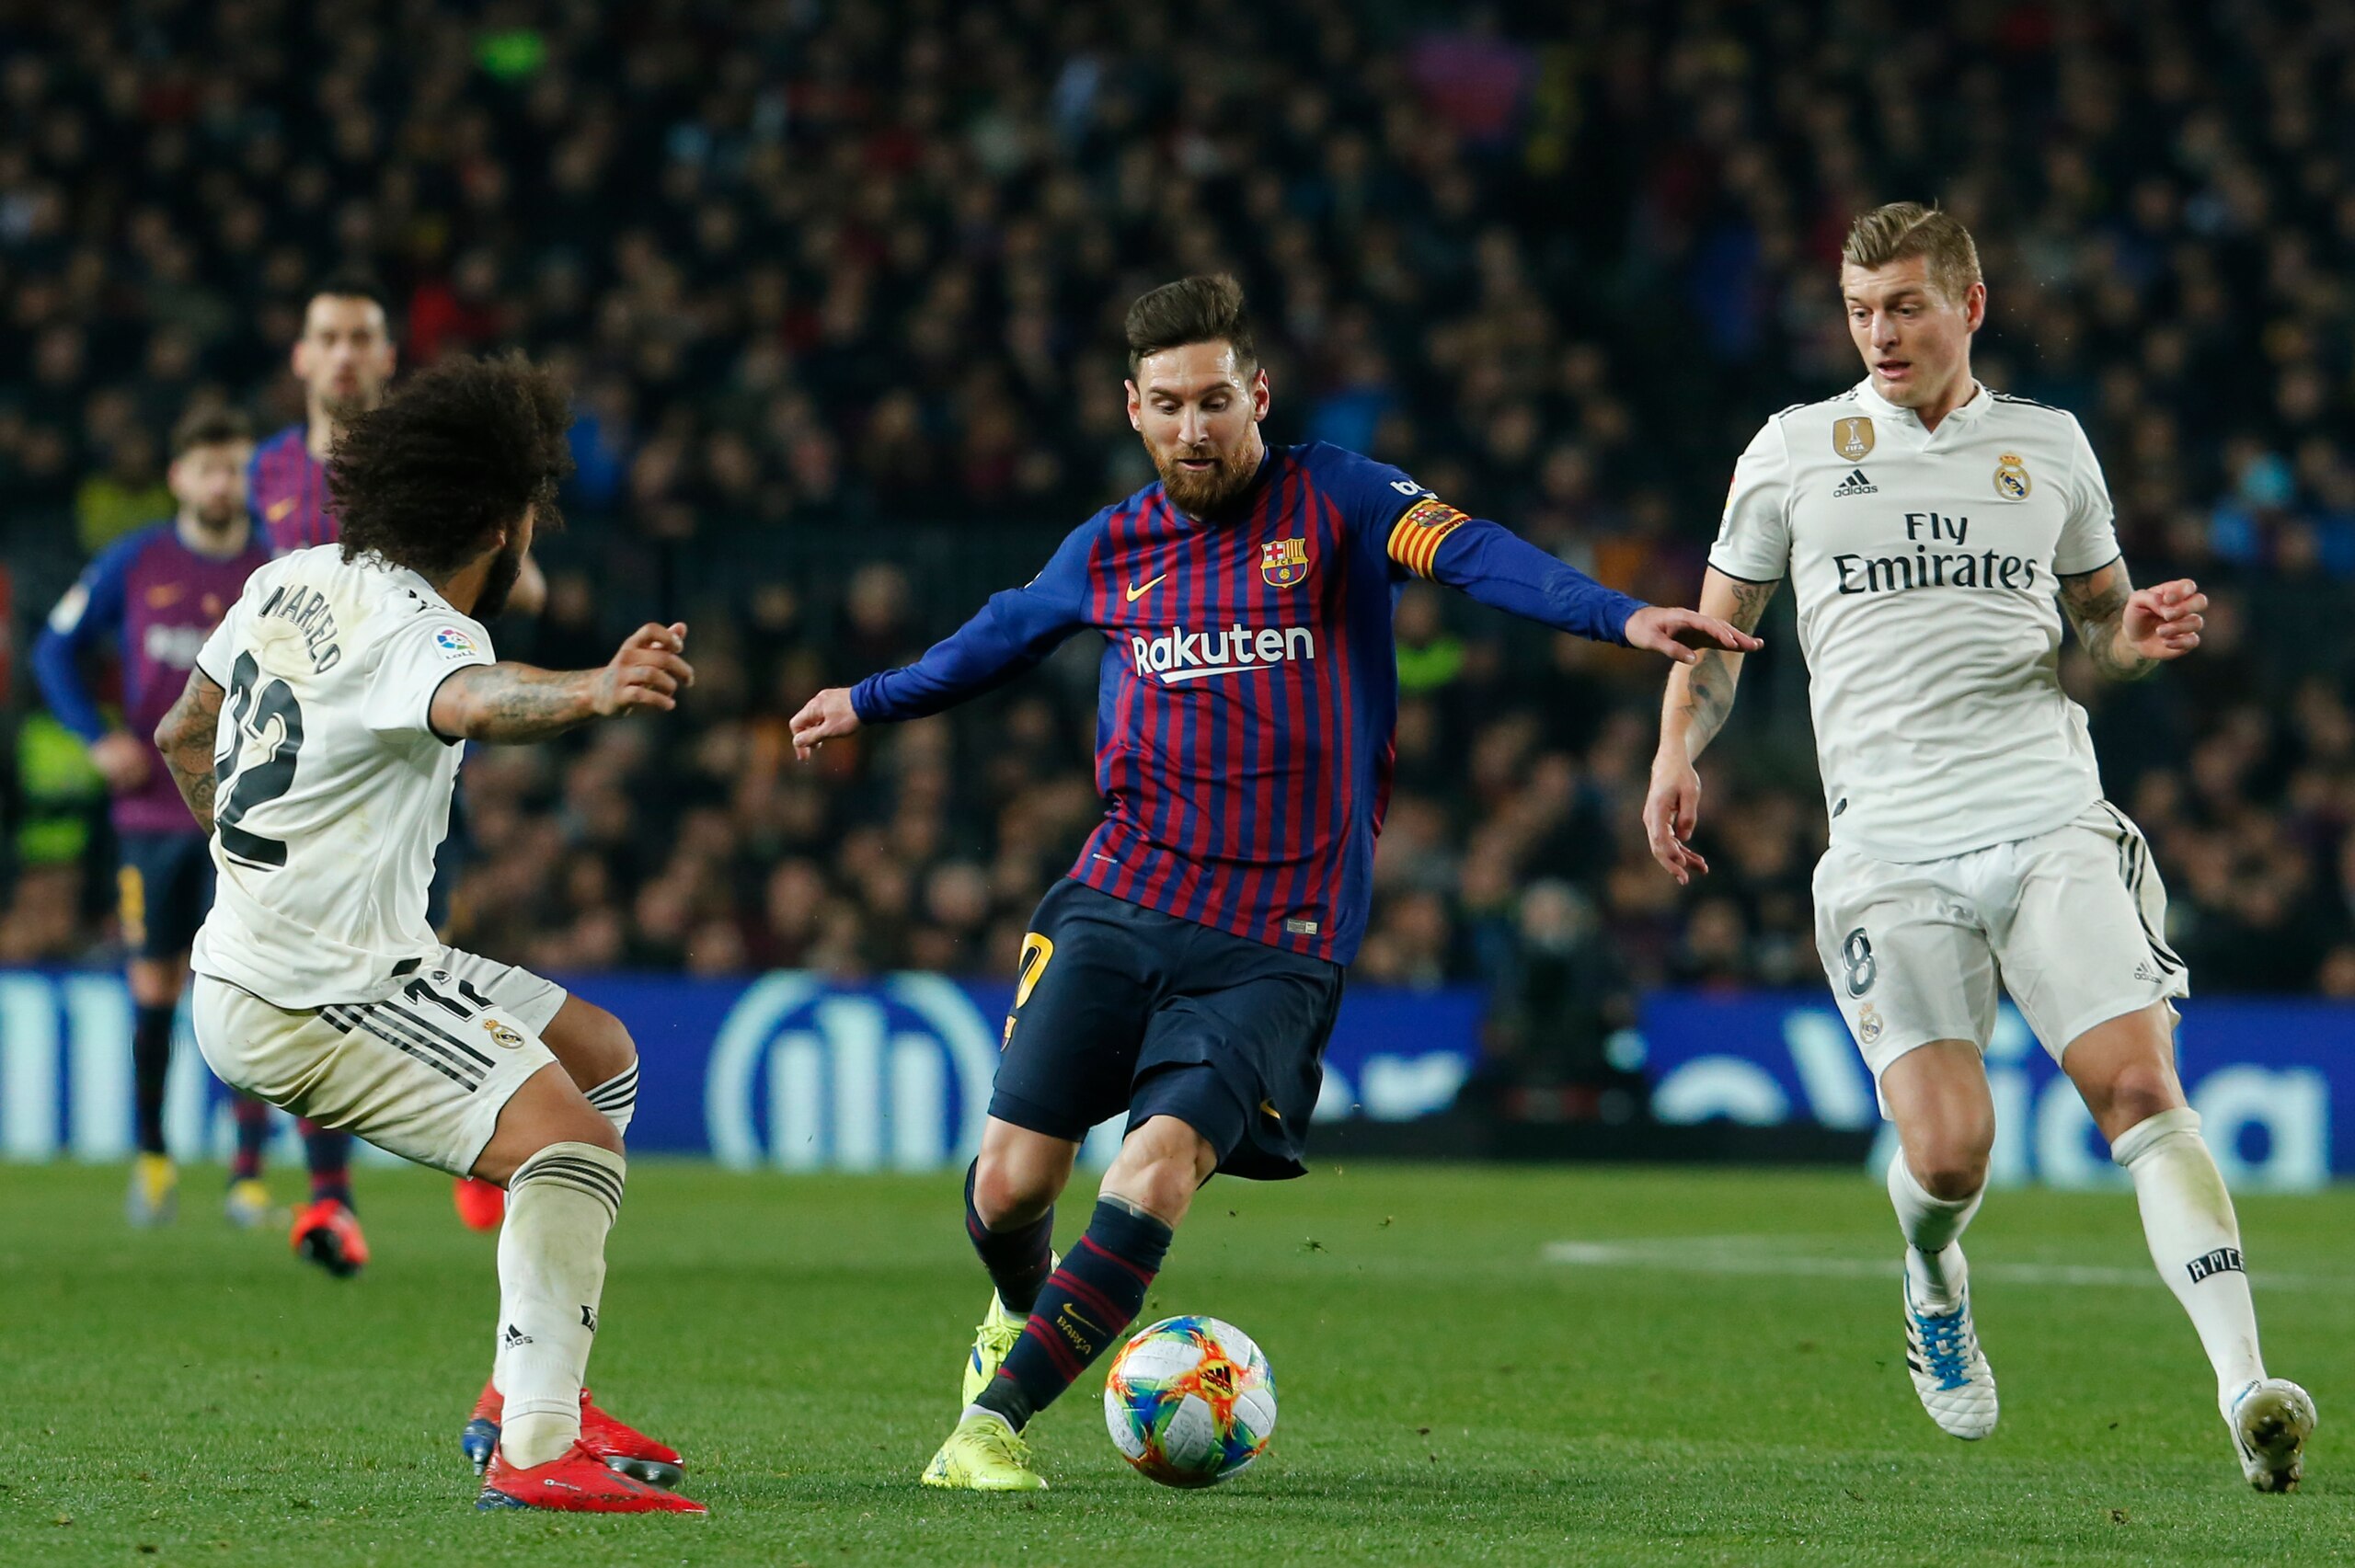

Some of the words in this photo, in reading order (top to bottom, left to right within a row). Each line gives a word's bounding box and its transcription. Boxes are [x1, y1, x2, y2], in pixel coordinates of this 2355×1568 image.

[1833, 486, 1878, 498] adidas
[1904, 512, 1968, 545] Fly
[1832, 544, 2037, 595] Emirates
[258, 584, 341, 675] MARCELO
[1132, 623, 1315, 677] Rakuten
[1841, 926, 1877, 1000] 8
